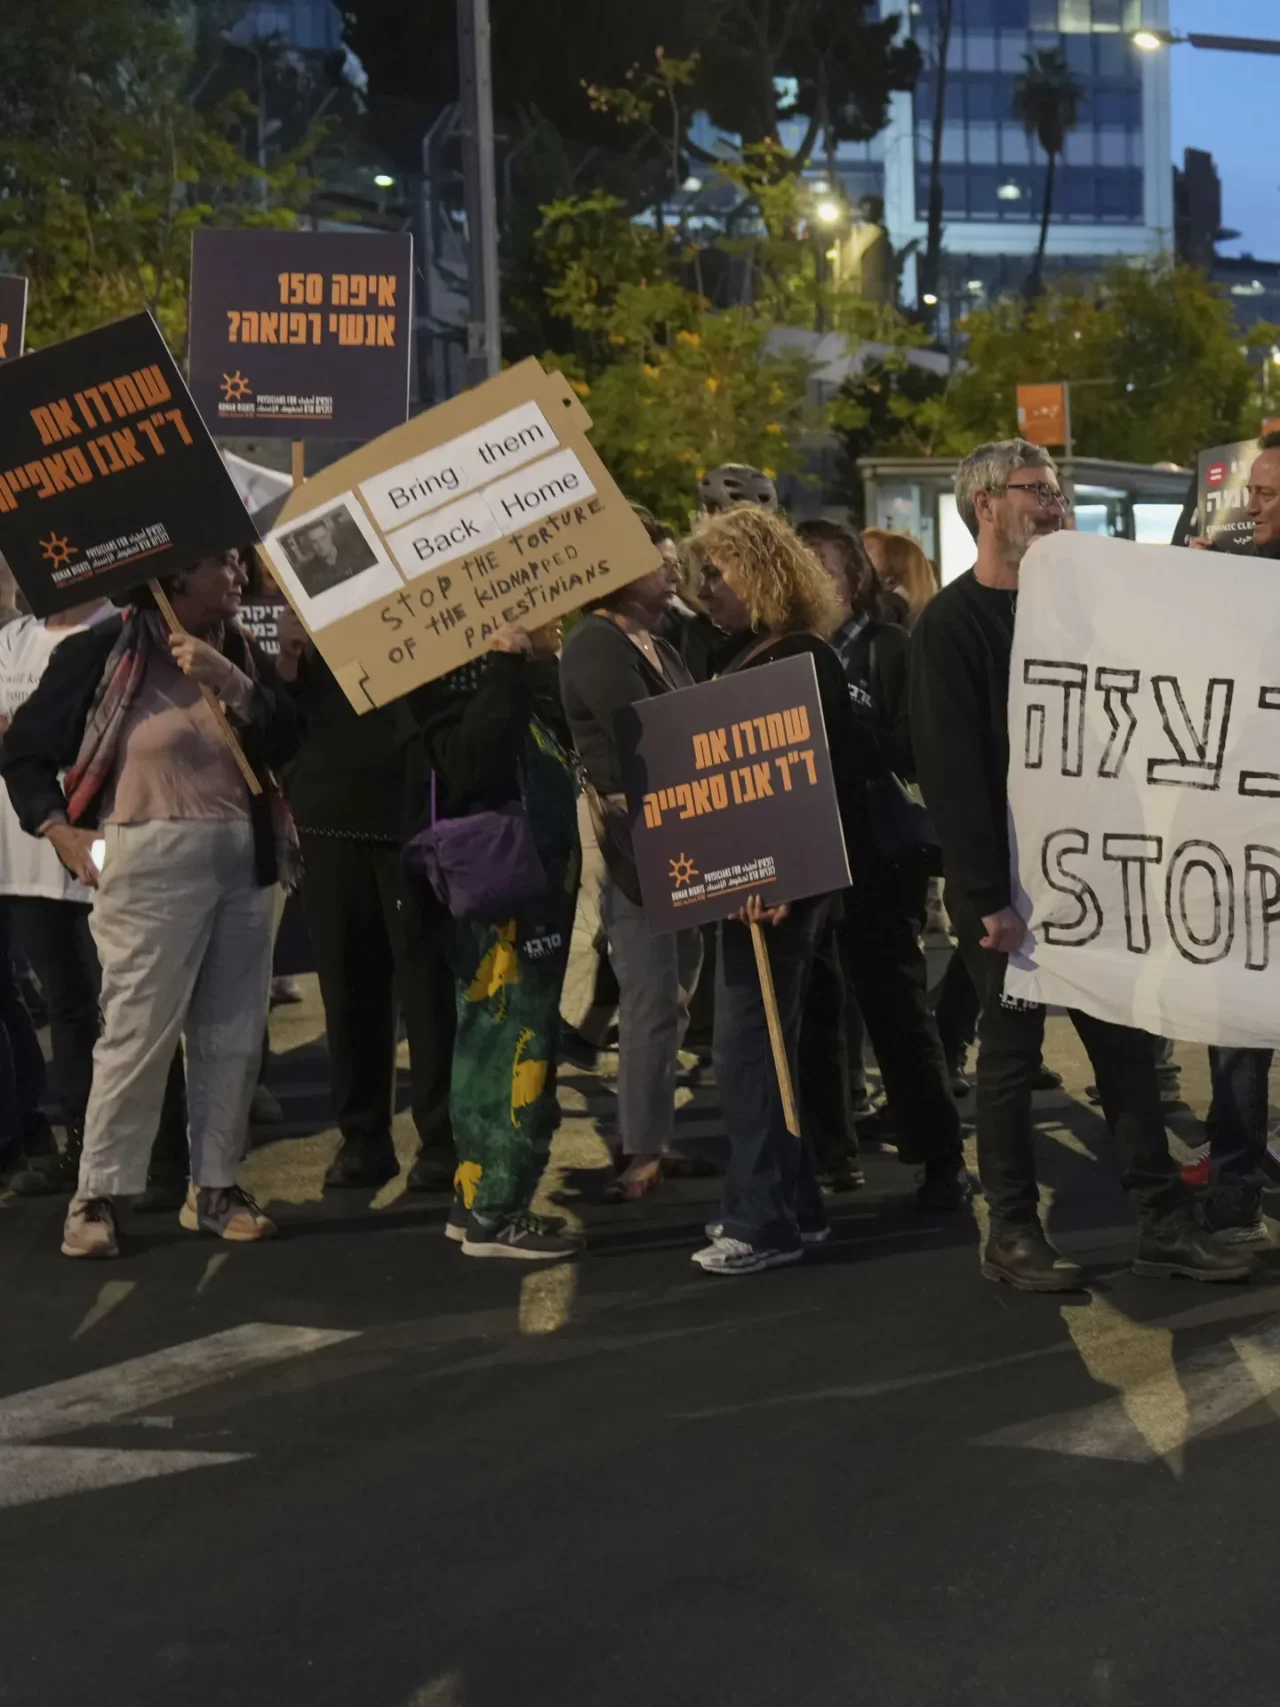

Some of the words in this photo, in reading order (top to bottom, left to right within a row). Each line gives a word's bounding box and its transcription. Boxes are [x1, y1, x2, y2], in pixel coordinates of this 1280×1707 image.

[278, 272, 323, 305] 150
[331, 273, 397, 307] איפה
[227, 310, 322, 345] רפואה?
[329, 313, 396, 347] אנשי
[74, 364, 171, 429] שחררו
[30, 399, 82, 446] את
[87, 427, 145, 476] אבו
[387, 467, 460, 510] Bring
[478, 423, 545, 465] them
[0, 445, 93, 513] סאפייה
[411, 518, 481, 561] Back
[500, 472, 580, 518] Home
[388, 637, 417, 665] OF
[692, 727, 731, 770] את
[731, 705, 811, 759] שחררו
[642, 773, 728, 828] סאפייה
[730, 761, 775, 805] אבו
